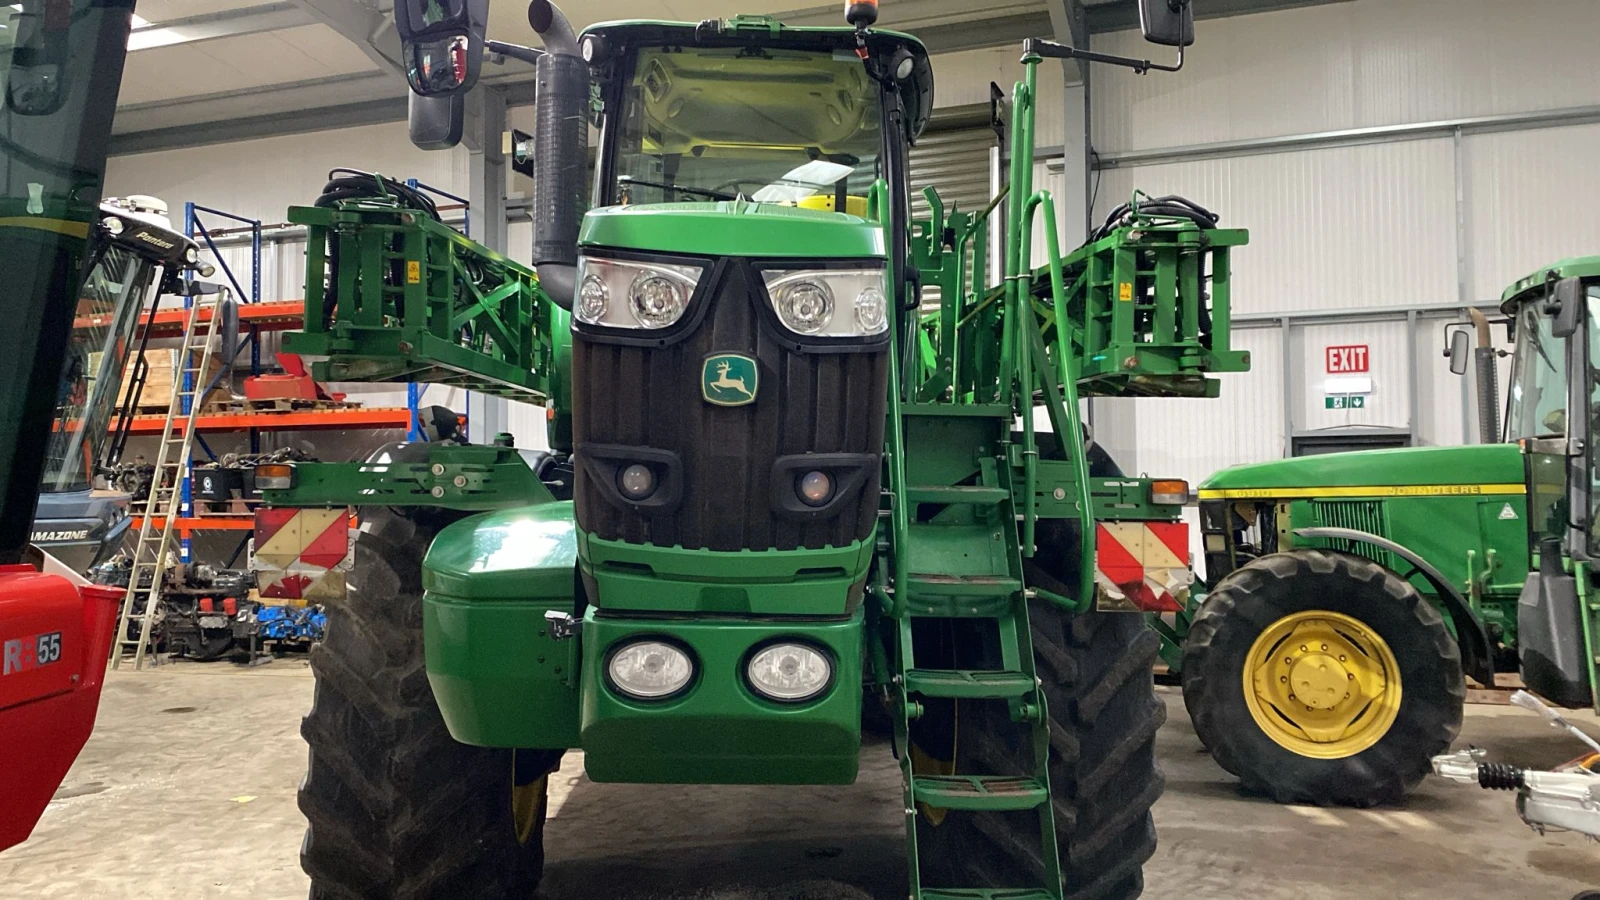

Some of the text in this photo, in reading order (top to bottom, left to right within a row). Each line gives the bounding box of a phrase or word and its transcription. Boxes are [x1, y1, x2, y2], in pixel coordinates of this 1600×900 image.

[136, 231, 174, 249] Pantera
[1328, 347, 1366, 371] EXIT
[1431, 485, 1480, 495] DEERE
